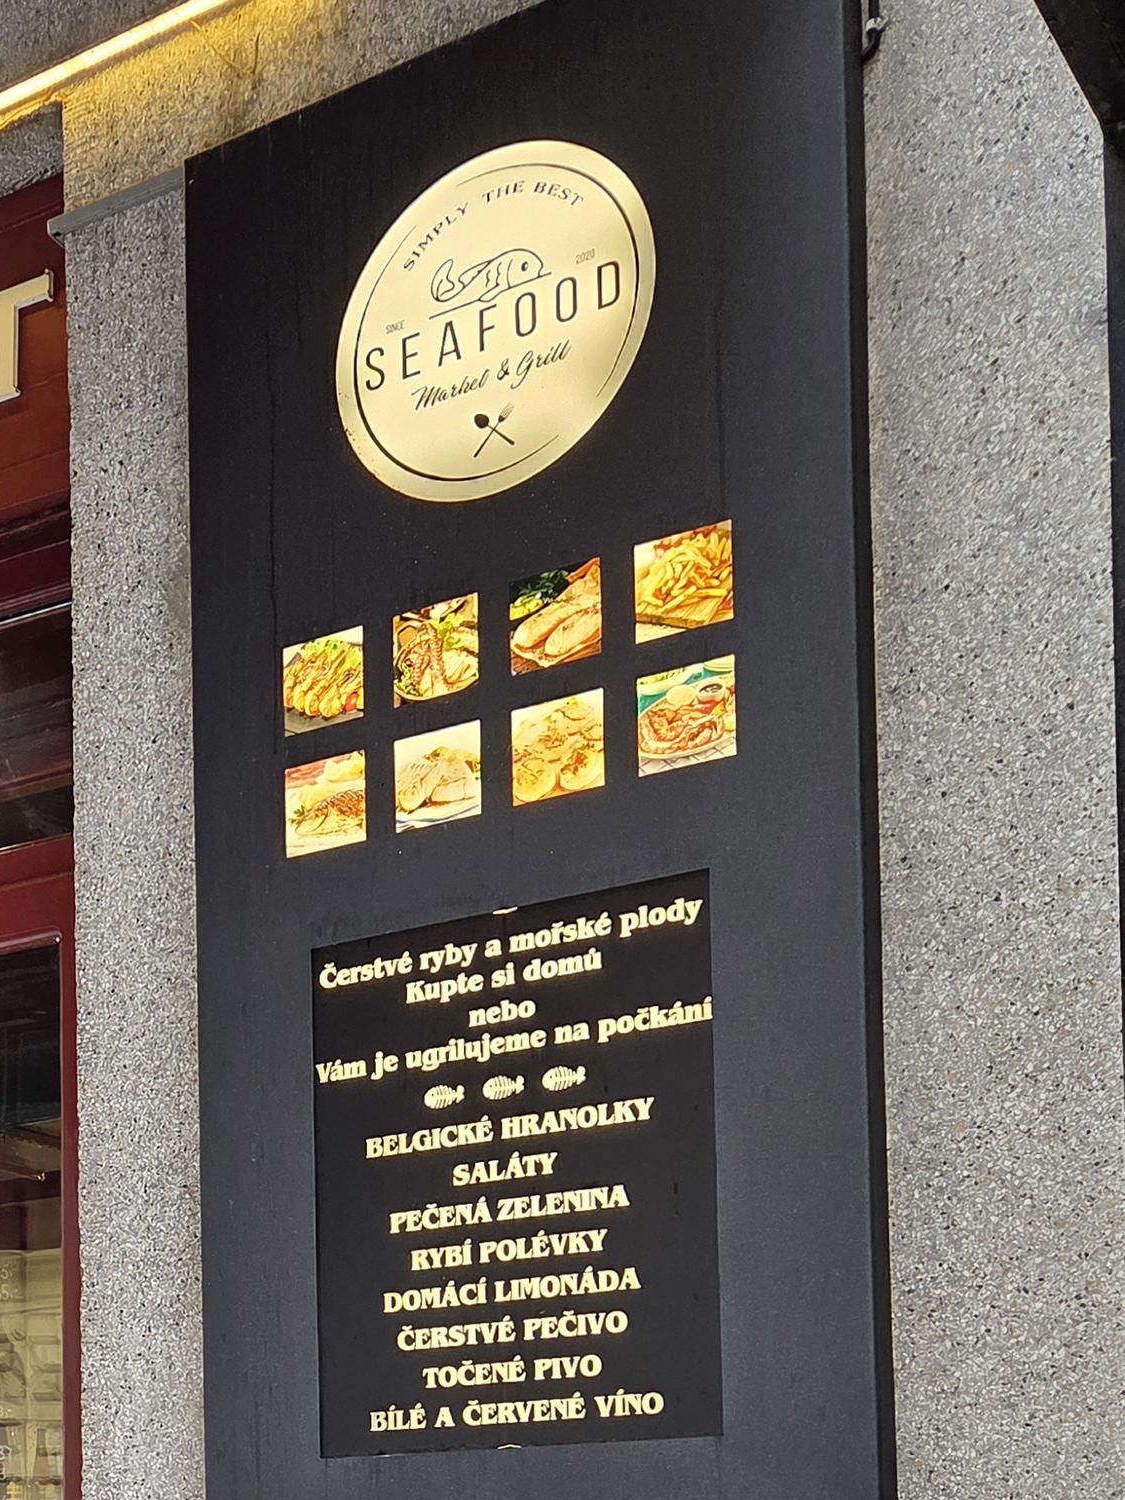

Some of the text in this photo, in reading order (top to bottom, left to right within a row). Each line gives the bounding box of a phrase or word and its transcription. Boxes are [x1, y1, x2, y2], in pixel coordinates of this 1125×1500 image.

[403, 180, 585, 272] SIMPLY THE BEST
[365, 259, 621, 392] SEAFOOD
[385, 319, 406, 335] SINCE
[411, 339, 572, 411] Market & Grill
[319, 898, 703, 990] Čerstvé ryby a mořské plody
[405, 948, 603, 1005] Kupte si domů
[468, 998, 536, 1028] nebo
[315, 997, 713, 1084] Vám je ugrilujeme na počkání
[365, 1096, 655, 1159] BELGICKÉ HRANOLKY
[452, 1151, 558, 1187] SALÁTY
[389, 1184, 631, 1234] PEČENÁ ZELENINA
[410, 1229, 608, 1271] RYBÍ POLÉVKY
[383, 1265, 642, 1313] DOMÁCÍ LIMONÁDA
[397, 1310, 629, 1352] ČERSTVÉ PEČIVO
[422, 1354, 602, 1389] TOČENÉ PIVO
[370, 1388, 665, 1432] BÍLÉ A ČERVENÉ VÍNO
